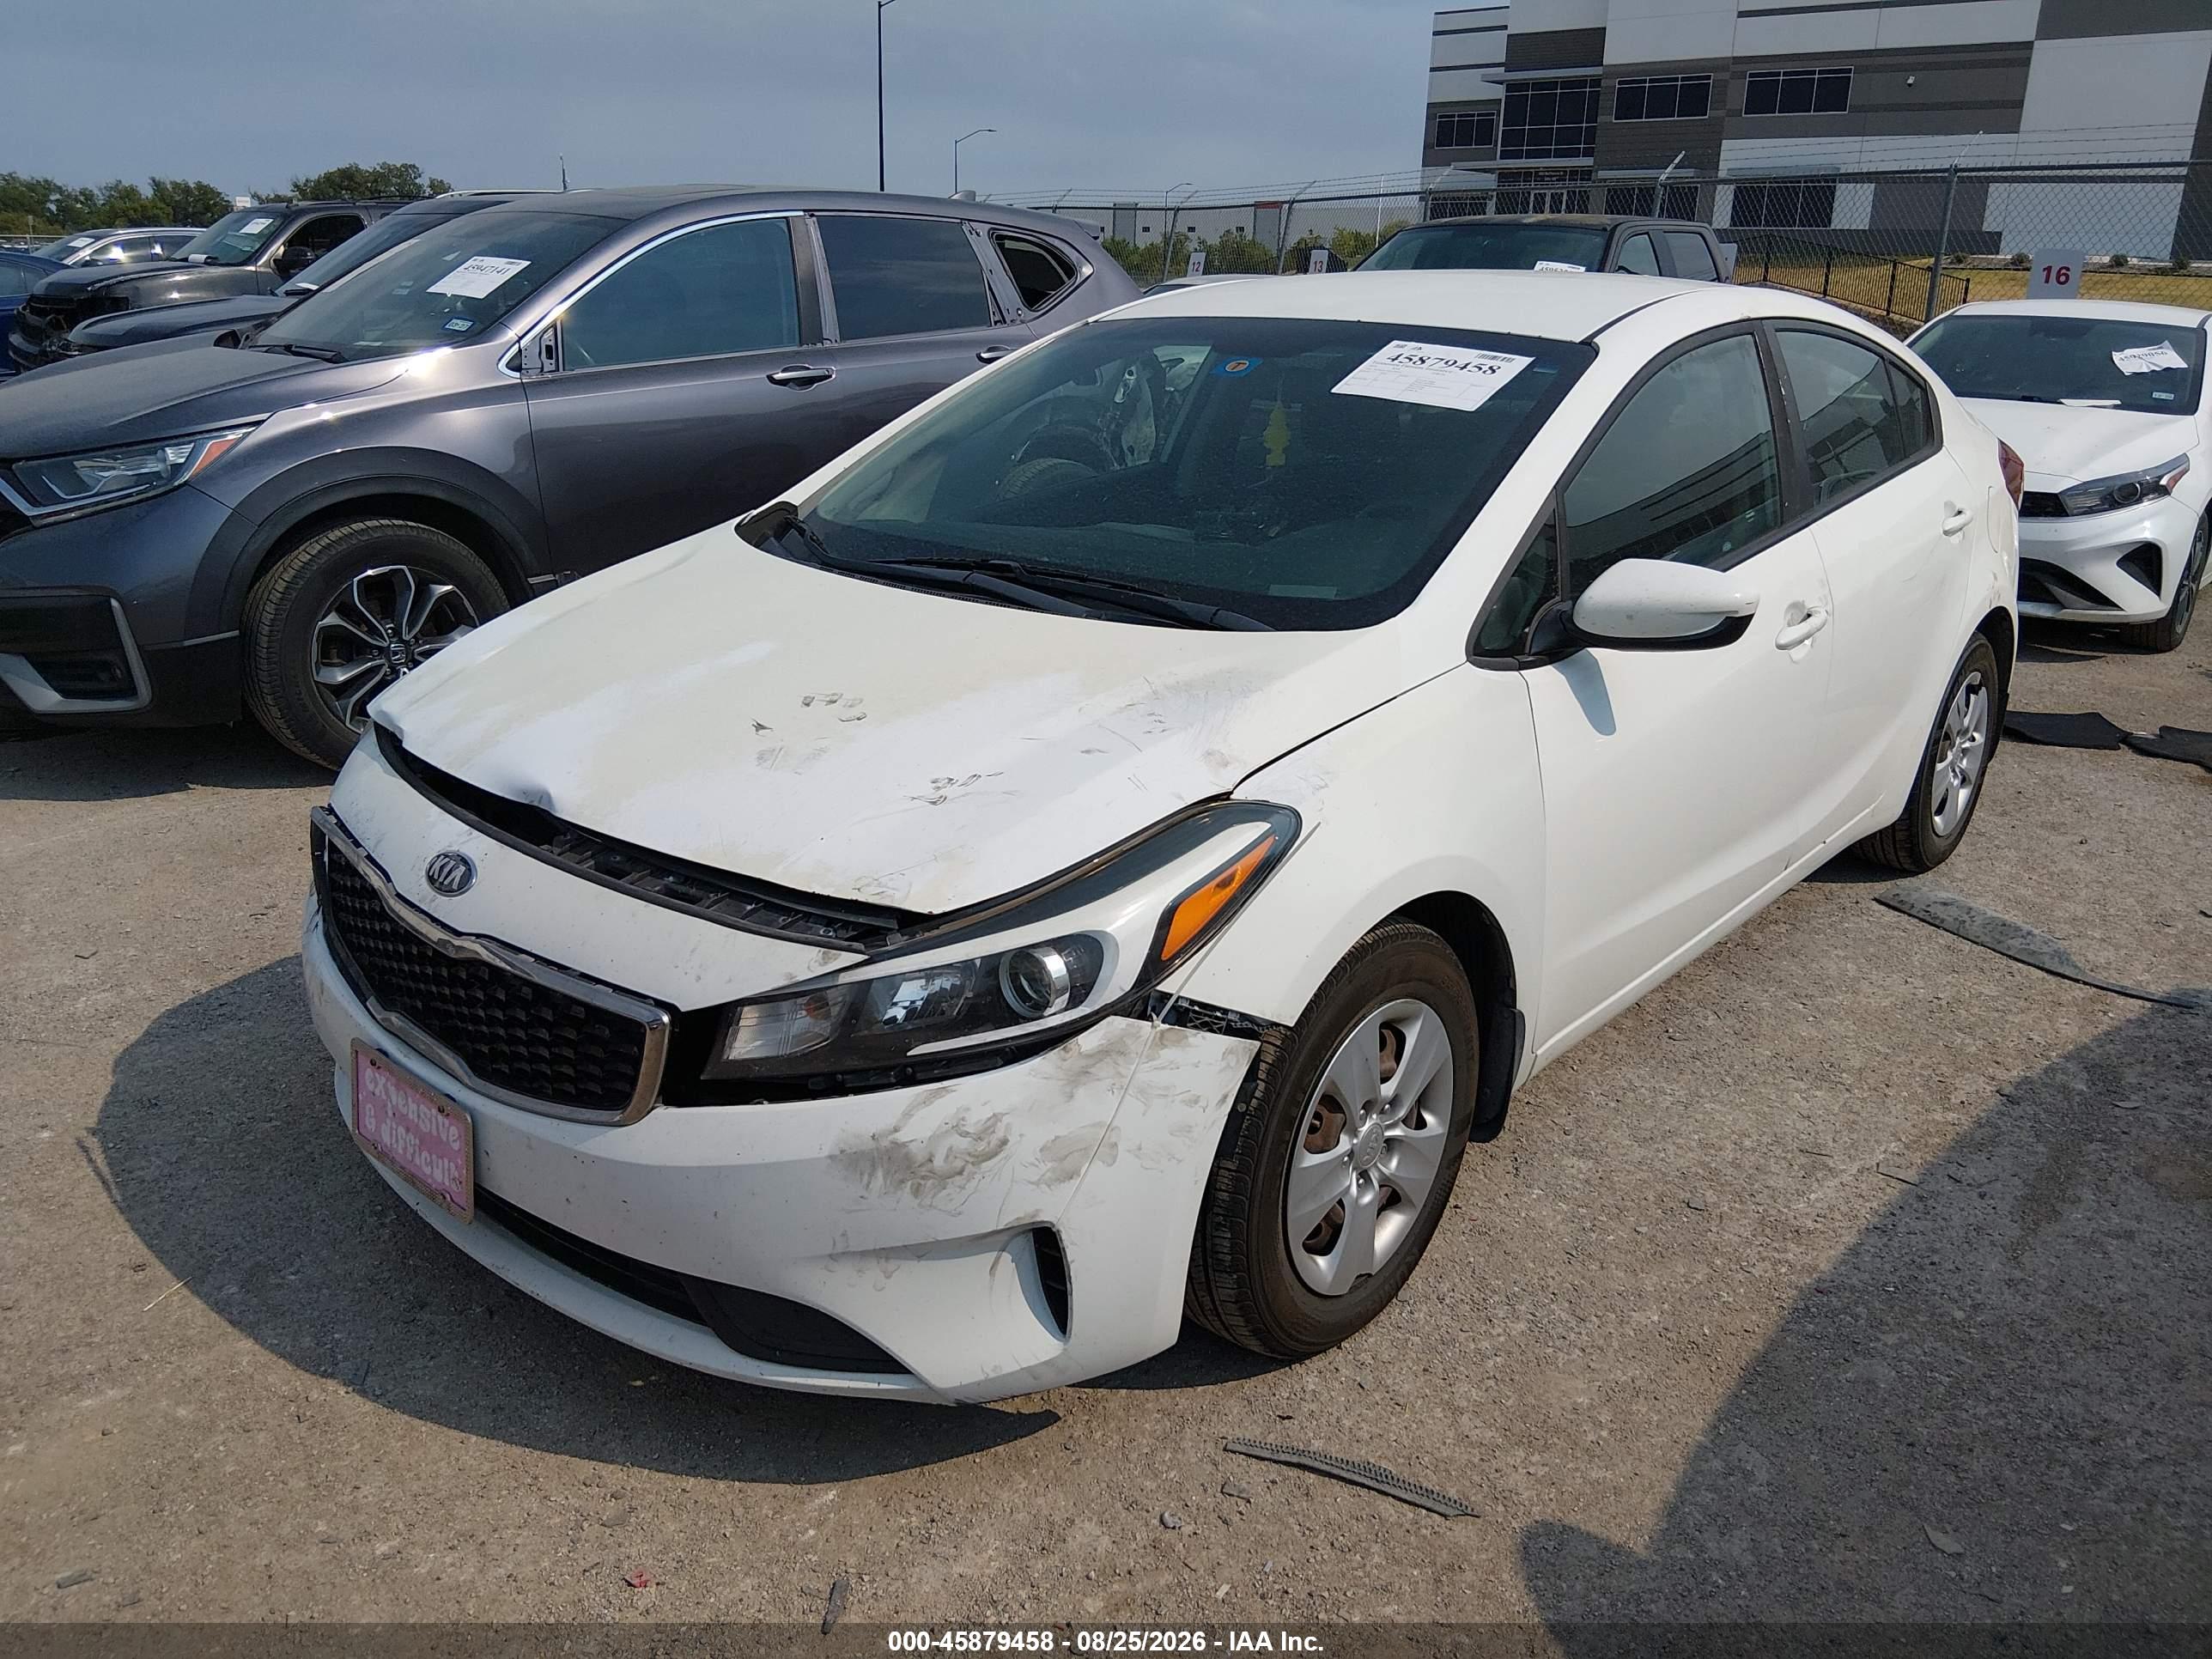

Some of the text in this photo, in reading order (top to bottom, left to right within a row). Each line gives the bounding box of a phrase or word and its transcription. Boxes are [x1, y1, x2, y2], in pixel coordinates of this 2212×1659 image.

[1192, 261, 1201, 272] 12
[1314, 260, 1323, 272] 13
[2042, 264, 2071, 285] 16
[1386, 352, 1502, 375] 45879458
[428, 854, 466, 890] KIA
[364, 1067, 461, 1152] expensive
[380, 1116, 462, 1192] difficult
